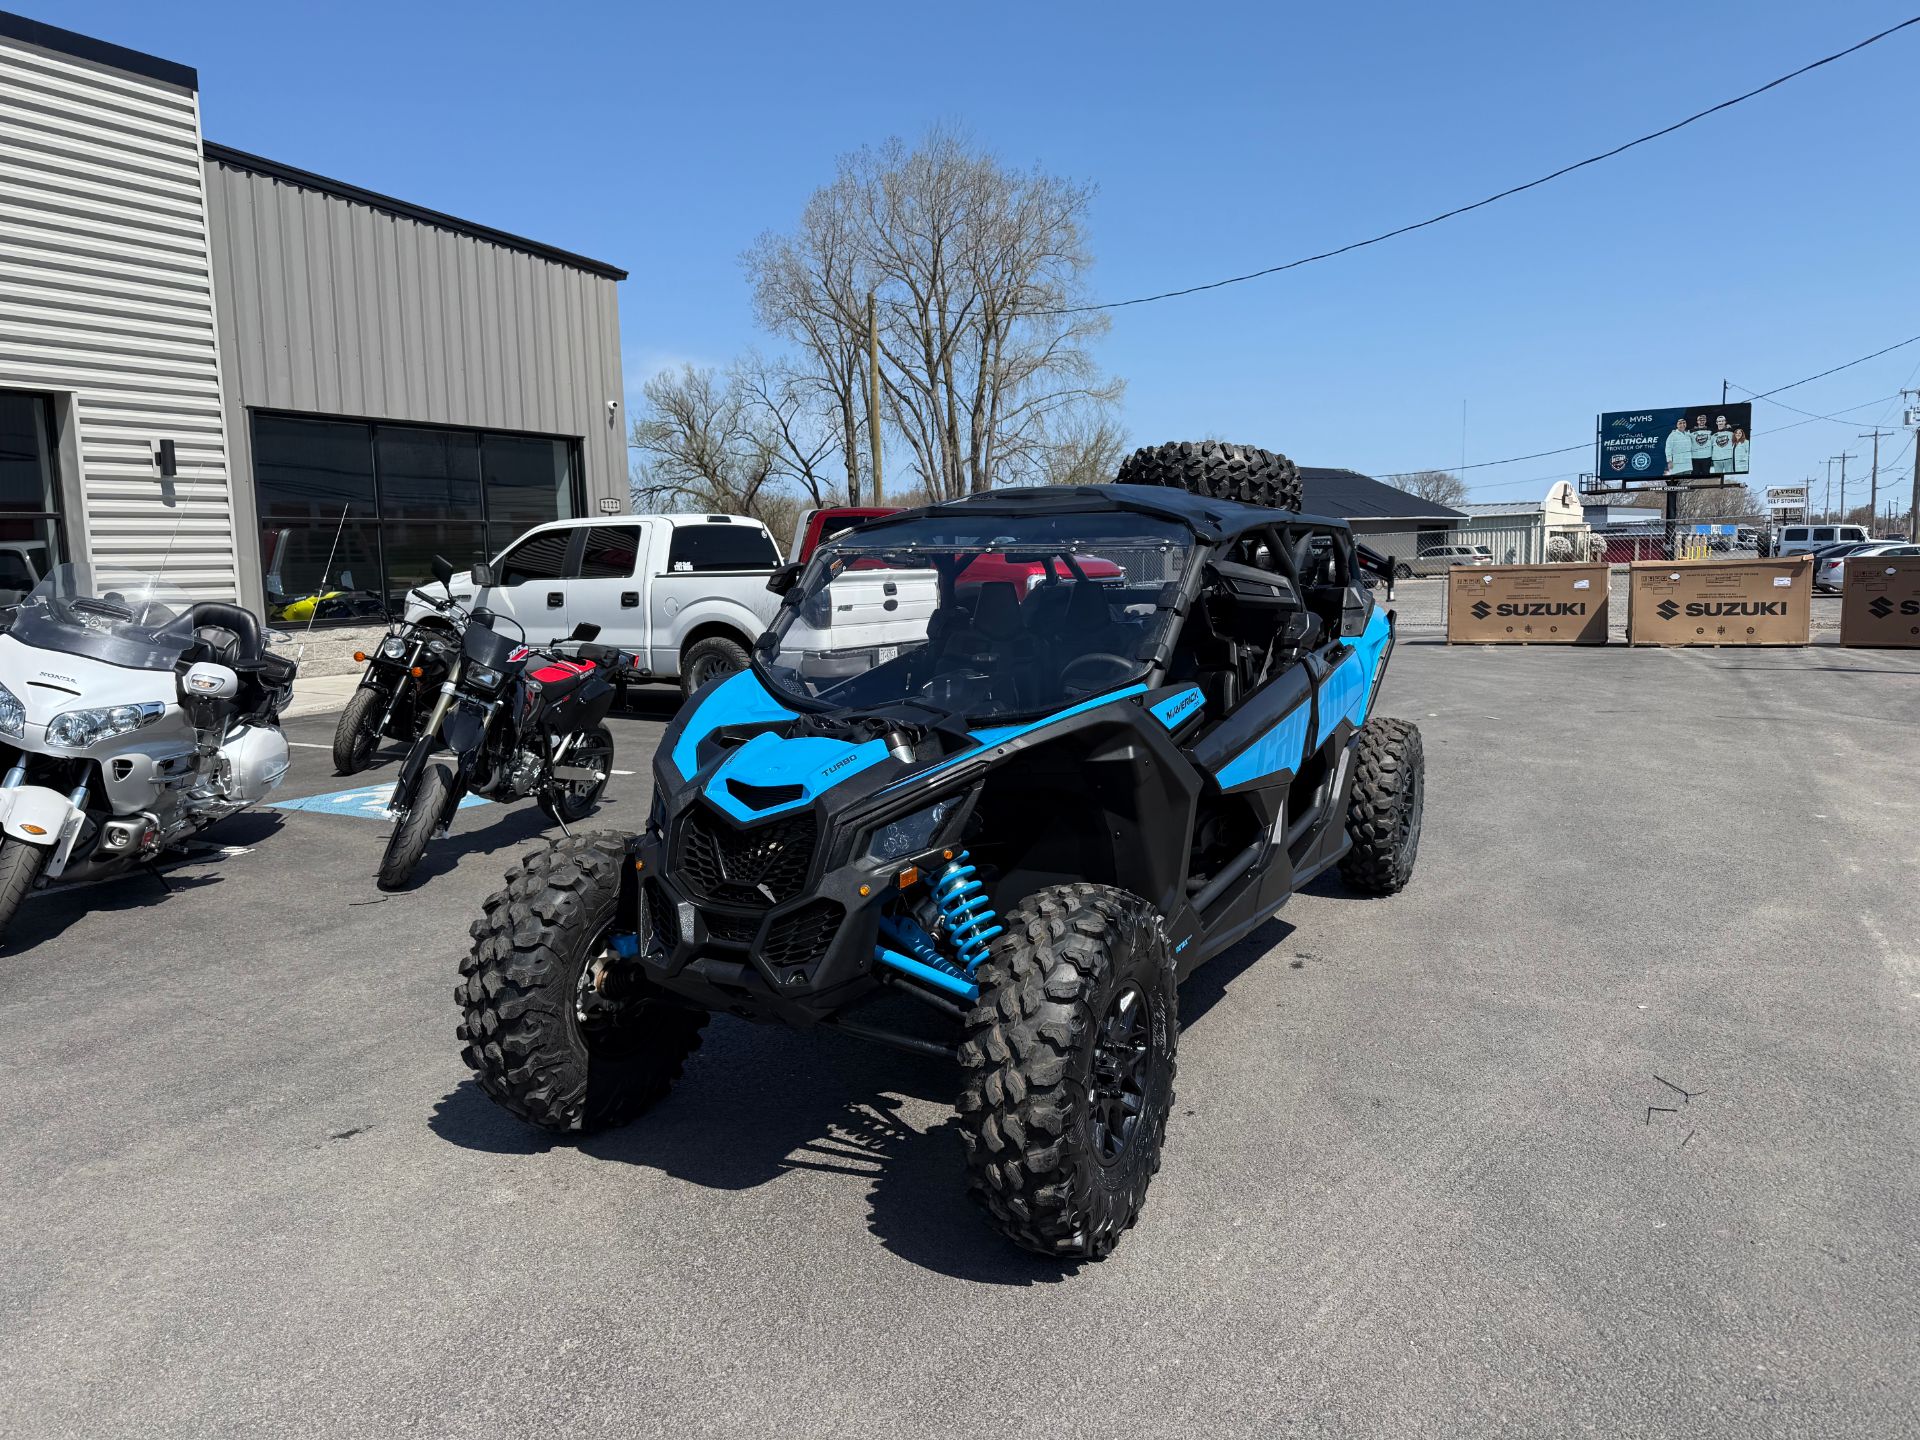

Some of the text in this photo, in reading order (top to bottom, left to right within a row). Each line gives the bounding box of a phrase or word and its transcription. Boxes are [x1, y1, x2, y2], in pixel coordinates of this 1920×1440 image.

[1604, 436, 1659, 446] HEALTHCARE
[1497, 602, 1586, 616] SUZUKI
[1685, 601, 1787, 617] SUZUKI
[40, 671, 78, 684] HONDA
[1166, 690, 1199, 720] MAVERICK
[821, 754, 858, 777] TURBO
